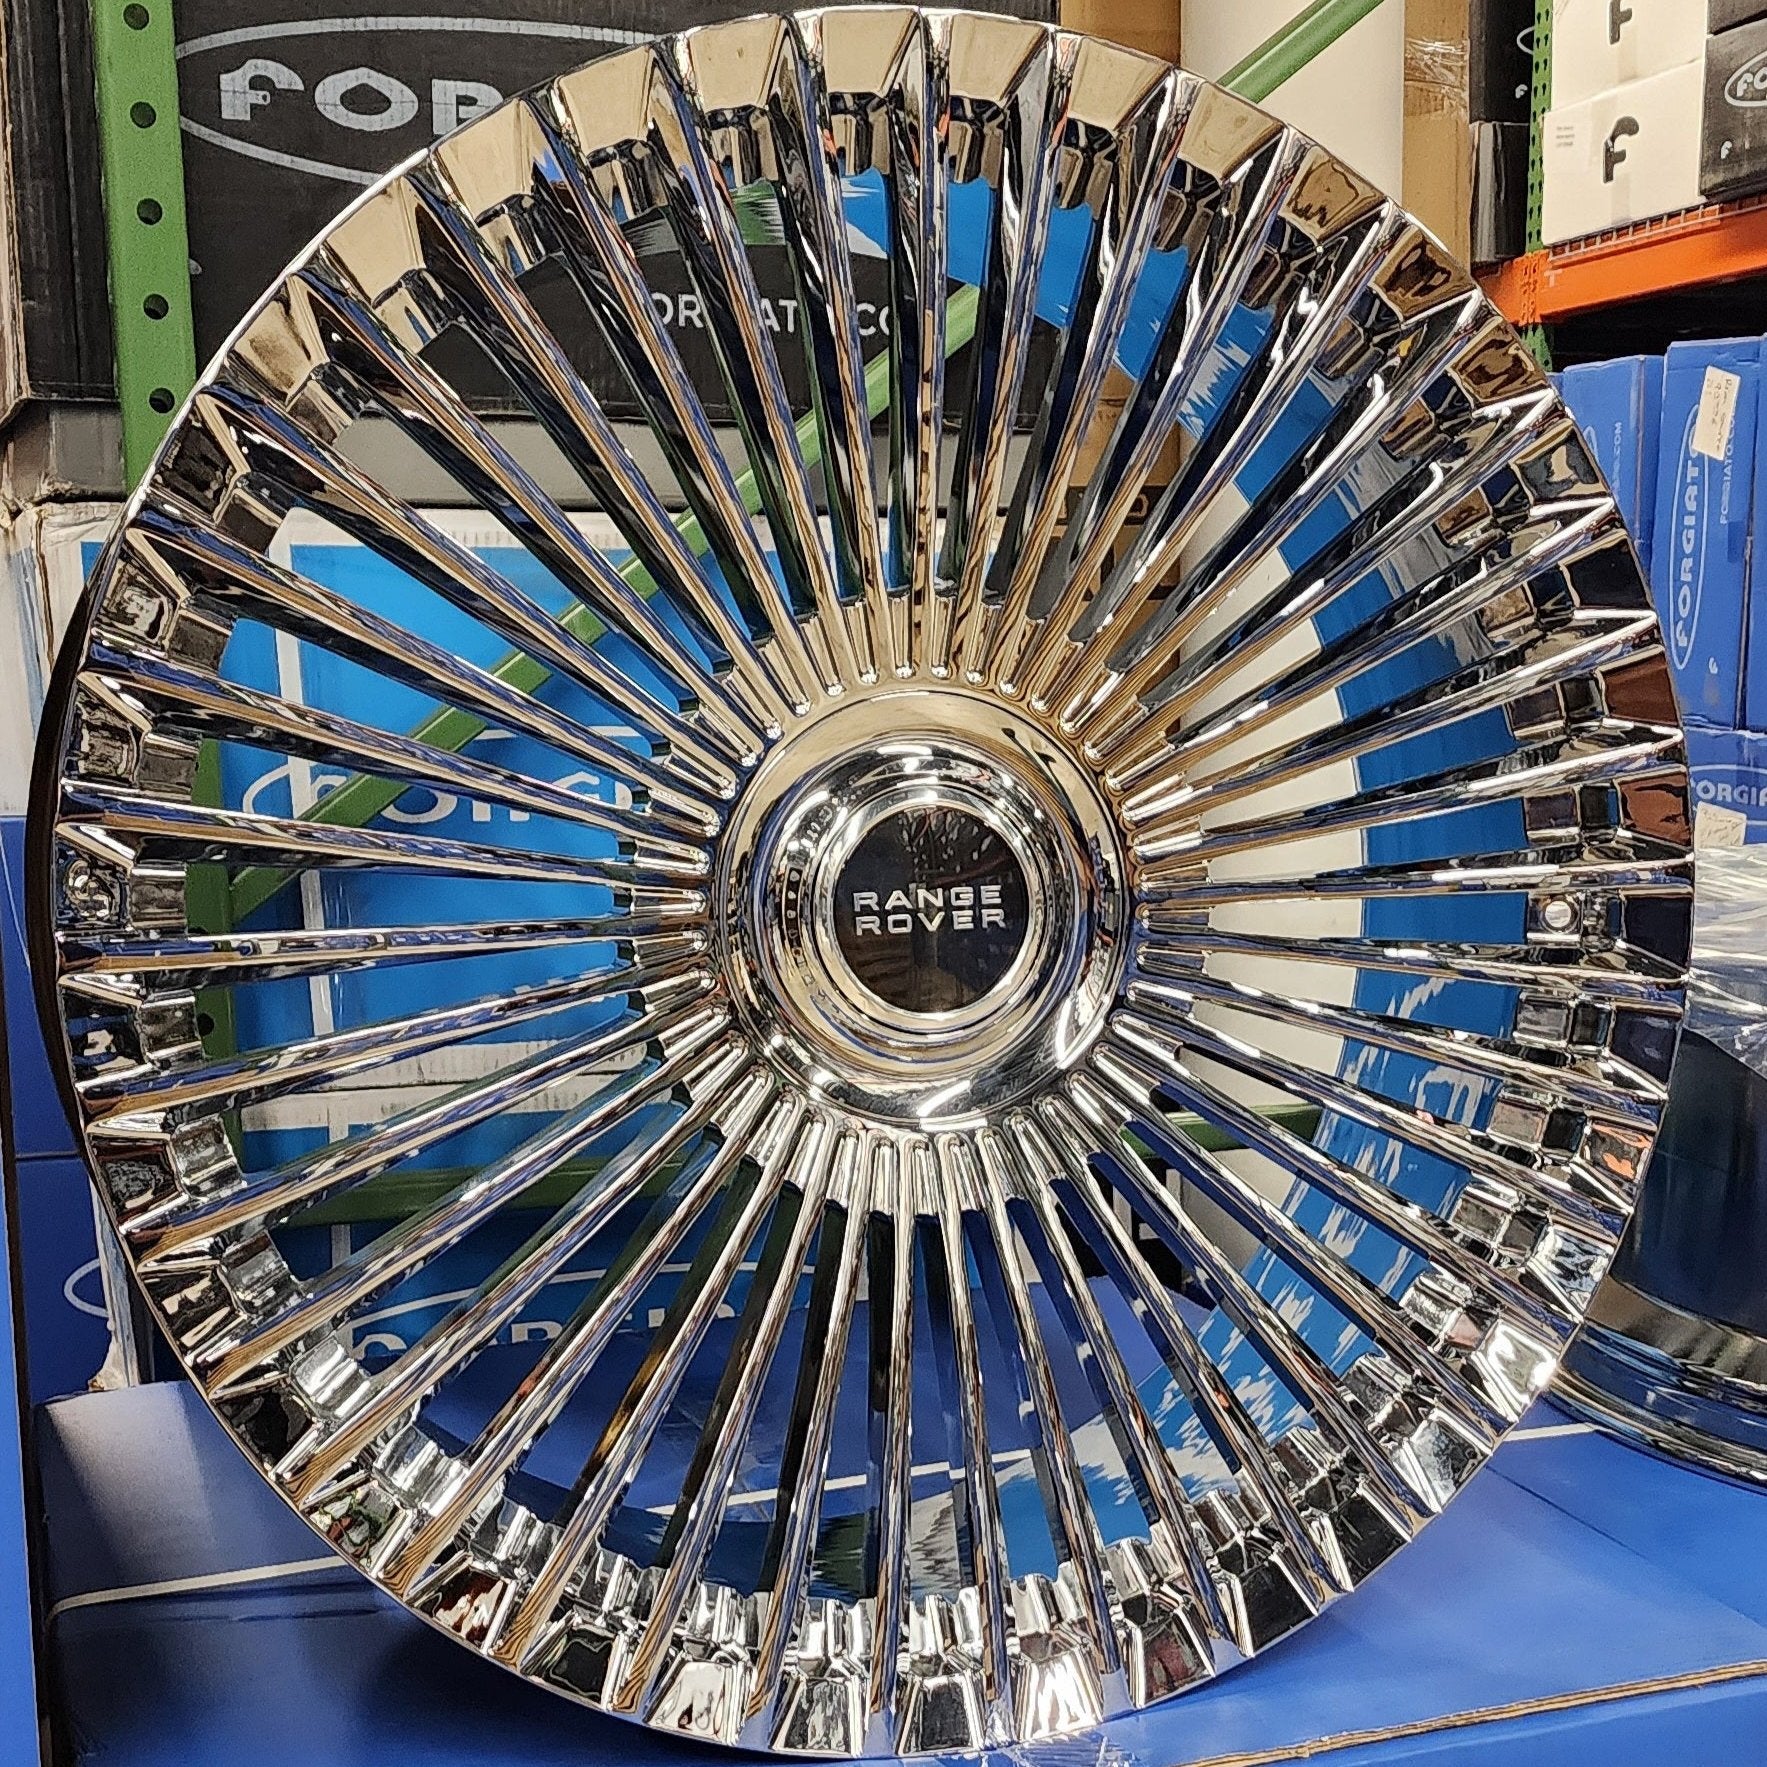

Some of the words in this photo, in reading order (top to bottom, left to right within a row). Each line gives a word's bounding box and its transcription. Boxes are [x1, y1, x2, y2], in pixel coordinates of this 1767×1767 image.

[1603, 115, 1640, 184] F
[853, 884, 1002, 912] RANGE
[855, 908, 1006, 936] ROVER
